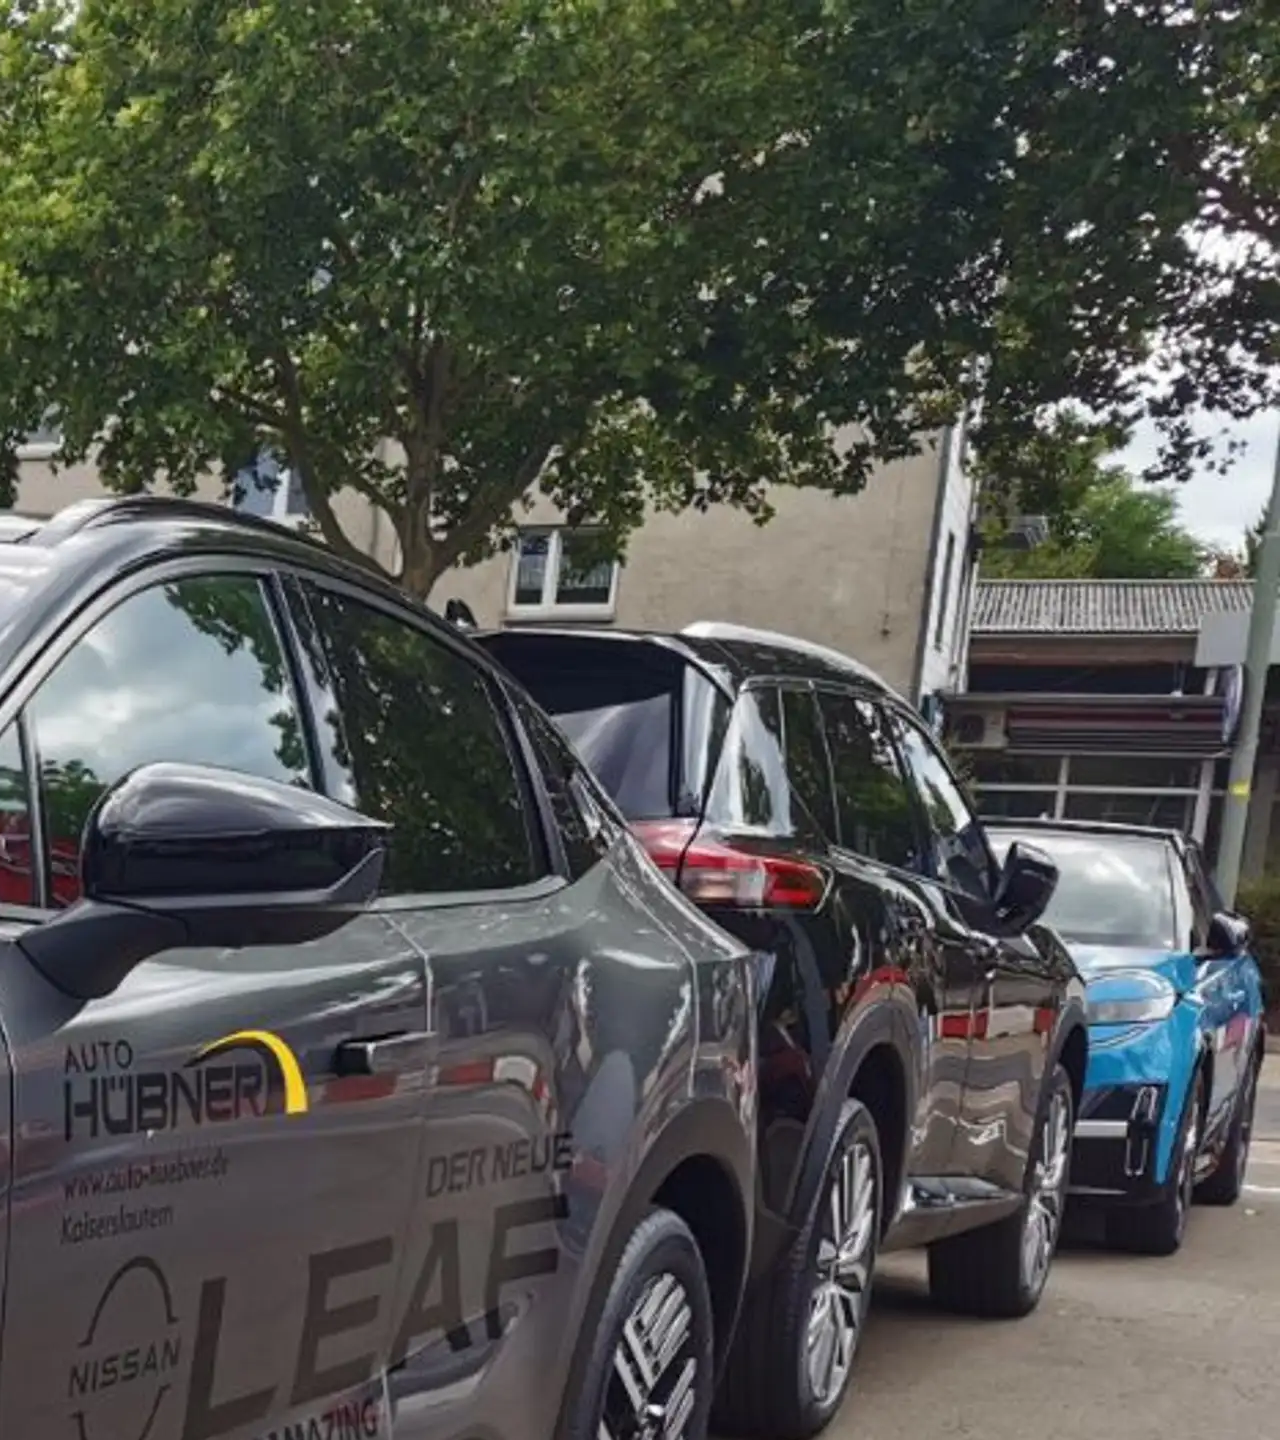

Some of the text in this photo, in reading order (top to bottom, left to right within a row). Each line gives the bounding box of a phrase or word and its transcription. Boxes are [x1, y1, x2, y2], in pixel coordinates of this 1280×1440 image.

[64, 1039, 133, 1075] AUTO
[64, 1064, 264, 1141] HÜBNER
[426, 1131, 573, 1198] DER NEUE
[69, 1337, 182, 1398] NISSAN
